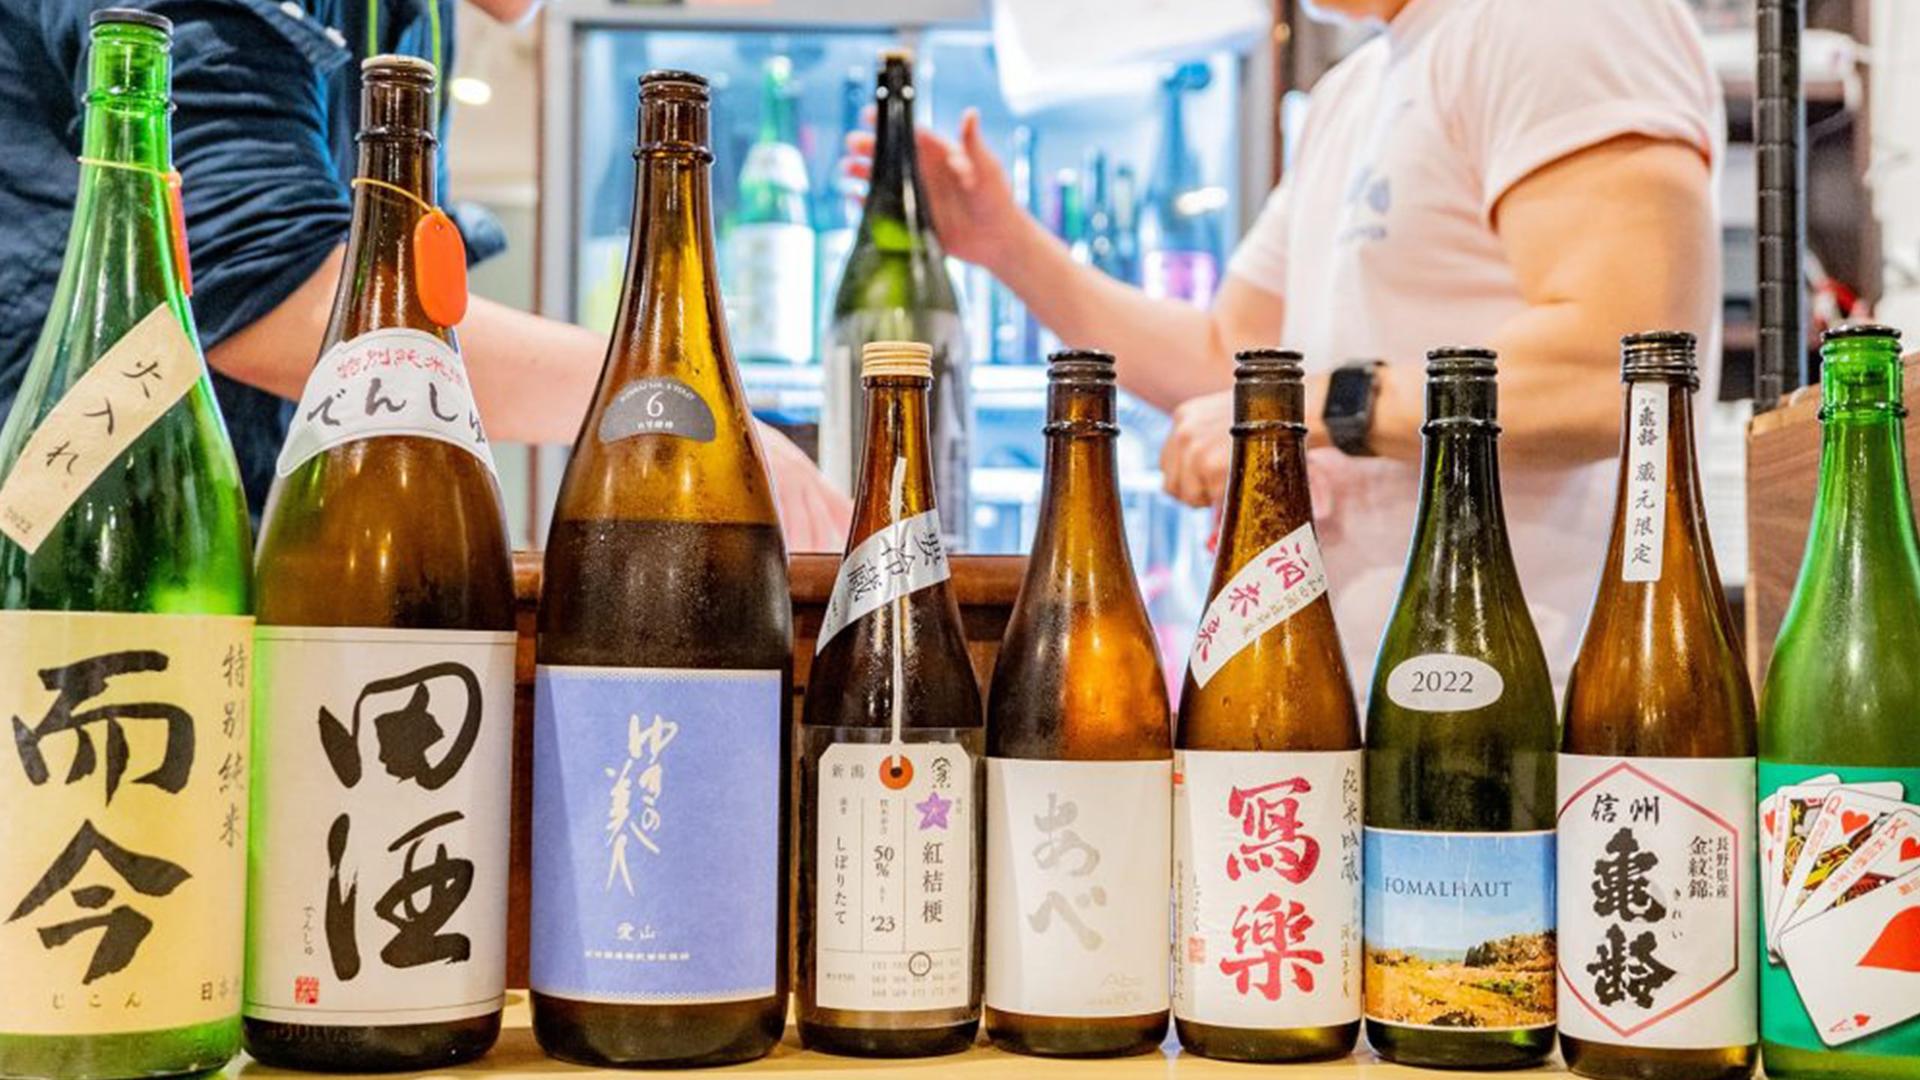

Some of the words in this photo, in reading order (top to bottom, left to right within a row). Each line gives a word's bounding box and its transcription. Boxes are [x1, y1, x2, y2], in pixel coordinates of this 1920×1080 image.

[45, 360, 163, 476] 火入れ
[306, 377, 486, 443] でんしゅ
[646, 391, 664, 417] 6
[1195, 542, 1312, 662] 酒未来
[1411, 671, 1474, 693] 2022
[217, 642, 246, 849] 特別純米
[4, 650, 196, 985] 而今
[318, 661, 483, 981] 田酒
[1591, 793, 1661, 825] 信州
[835, 836, 848, 925] しぼりたて
[922, 842, 943, 924] 紅桔梗
[1028, 793, 1107, 951] あべ
[1385, 878, 1512, 898] FOMALHAUT
[1688, 835, 1708, 899] 金紋錦
[1716, 836, 1729, 898] 長野県産
[871, 916, 896, 933] '23
[1672, 888, 1683, 940] きれい
[52, 992, 141, 1010] じこん
